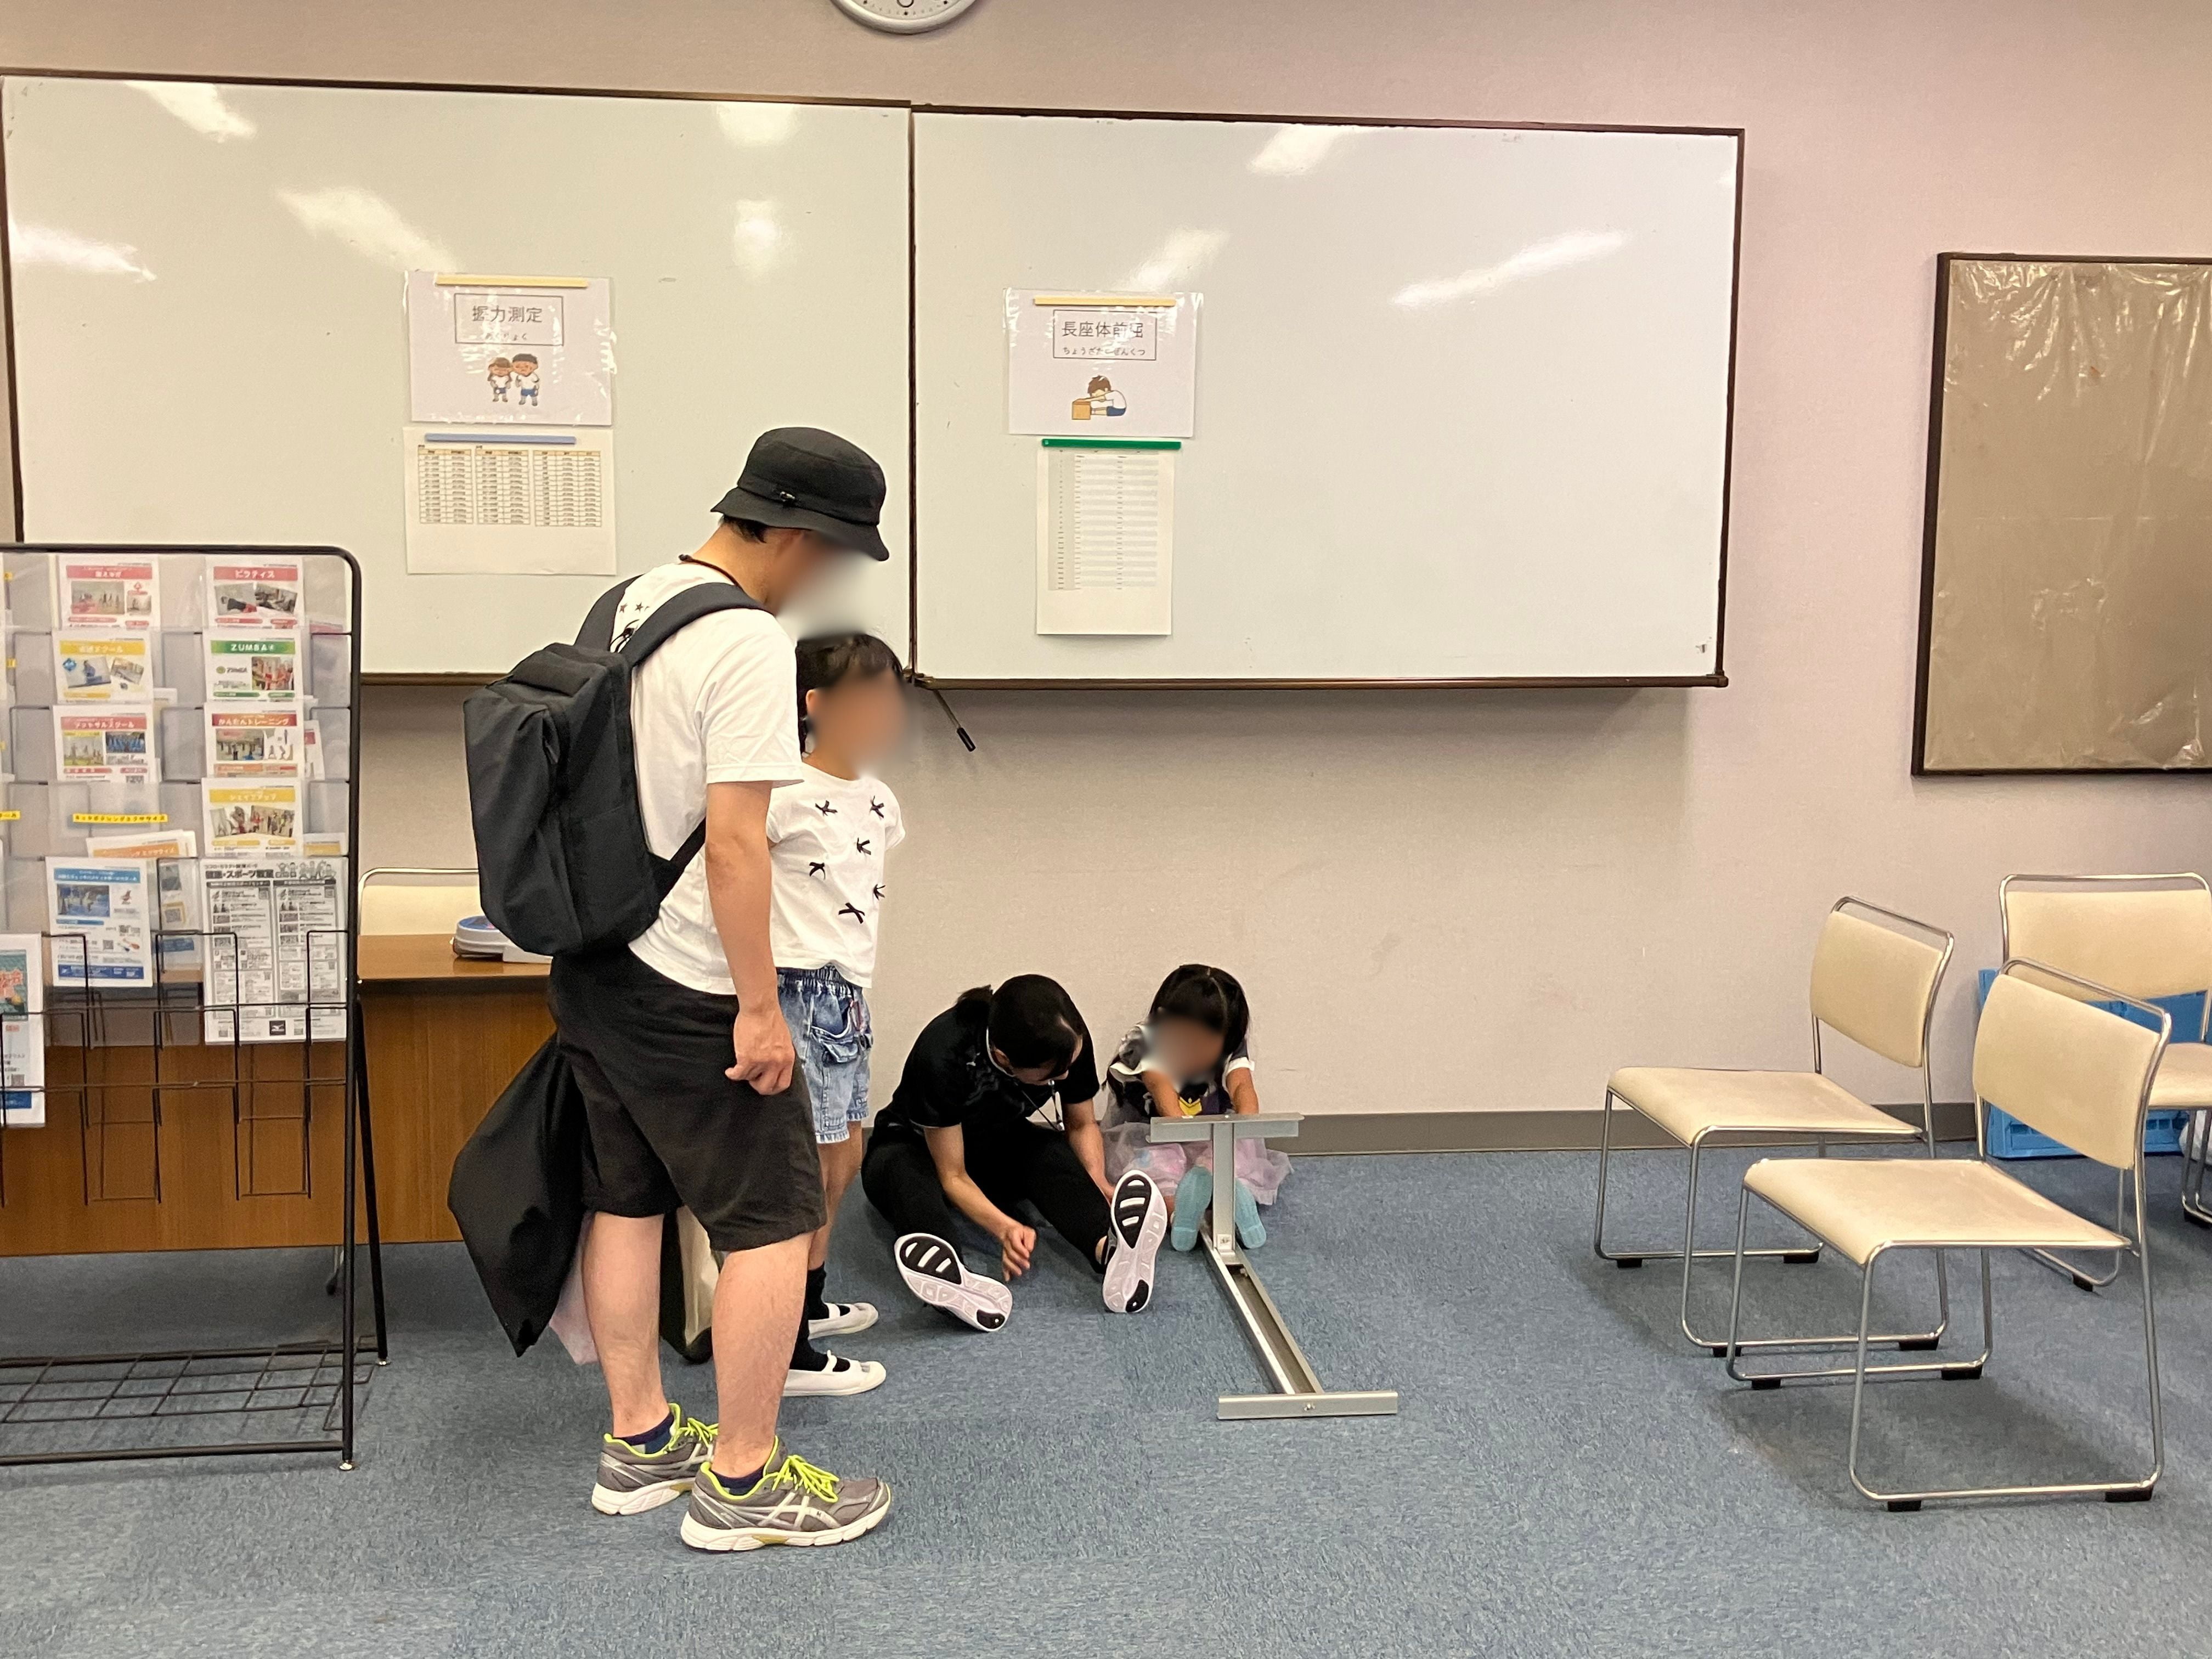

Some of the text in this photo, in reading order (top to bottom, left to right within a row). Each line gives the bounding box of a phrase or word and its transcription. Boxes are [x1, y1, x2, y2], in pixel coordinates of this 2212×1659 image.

[1062, 321, 1143, 338] 長座体前屈
